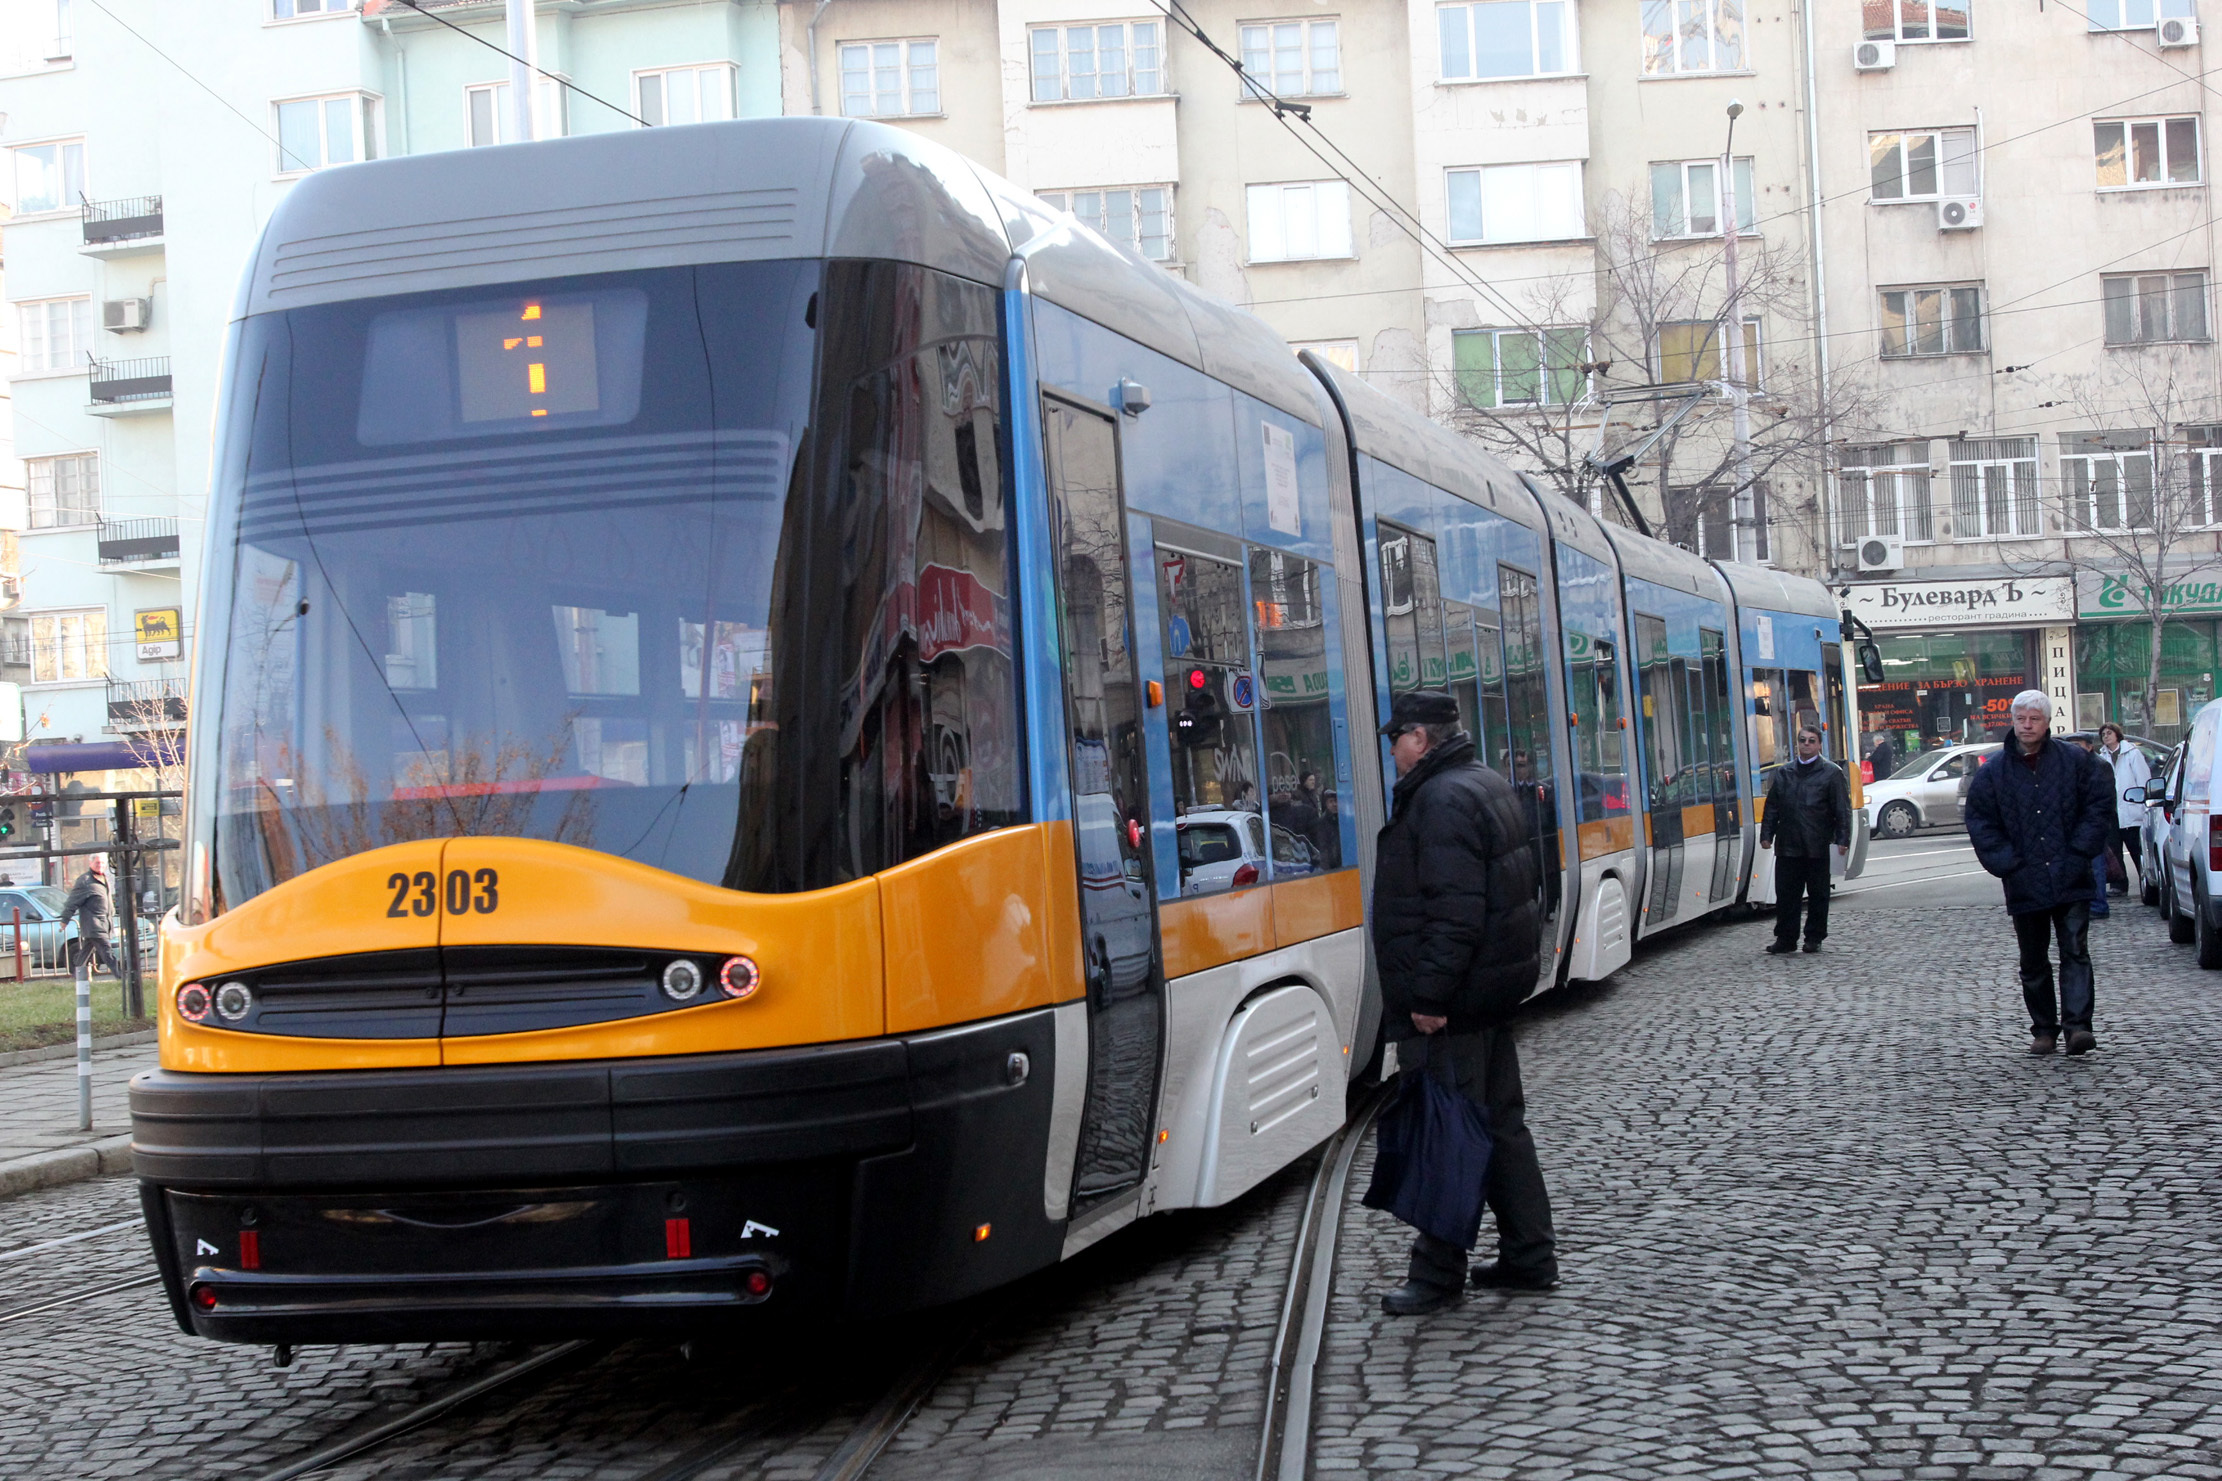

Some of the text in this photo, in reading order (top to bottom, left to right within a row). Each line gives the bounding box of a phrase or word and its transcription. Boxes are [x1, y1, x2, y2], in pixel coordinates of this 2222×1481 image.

[1881, 583, 2023, 612] Булевард Ъ
[1928, 612, 2027, 622] ресторант градина
[142, 645, 161, 656] Agip
[1933, 679, 1968, 688] БЪРЗО
[1974, 676, 2023, 686] ХРАНЕНЕ
[387, 868, 499, 917] 2303
